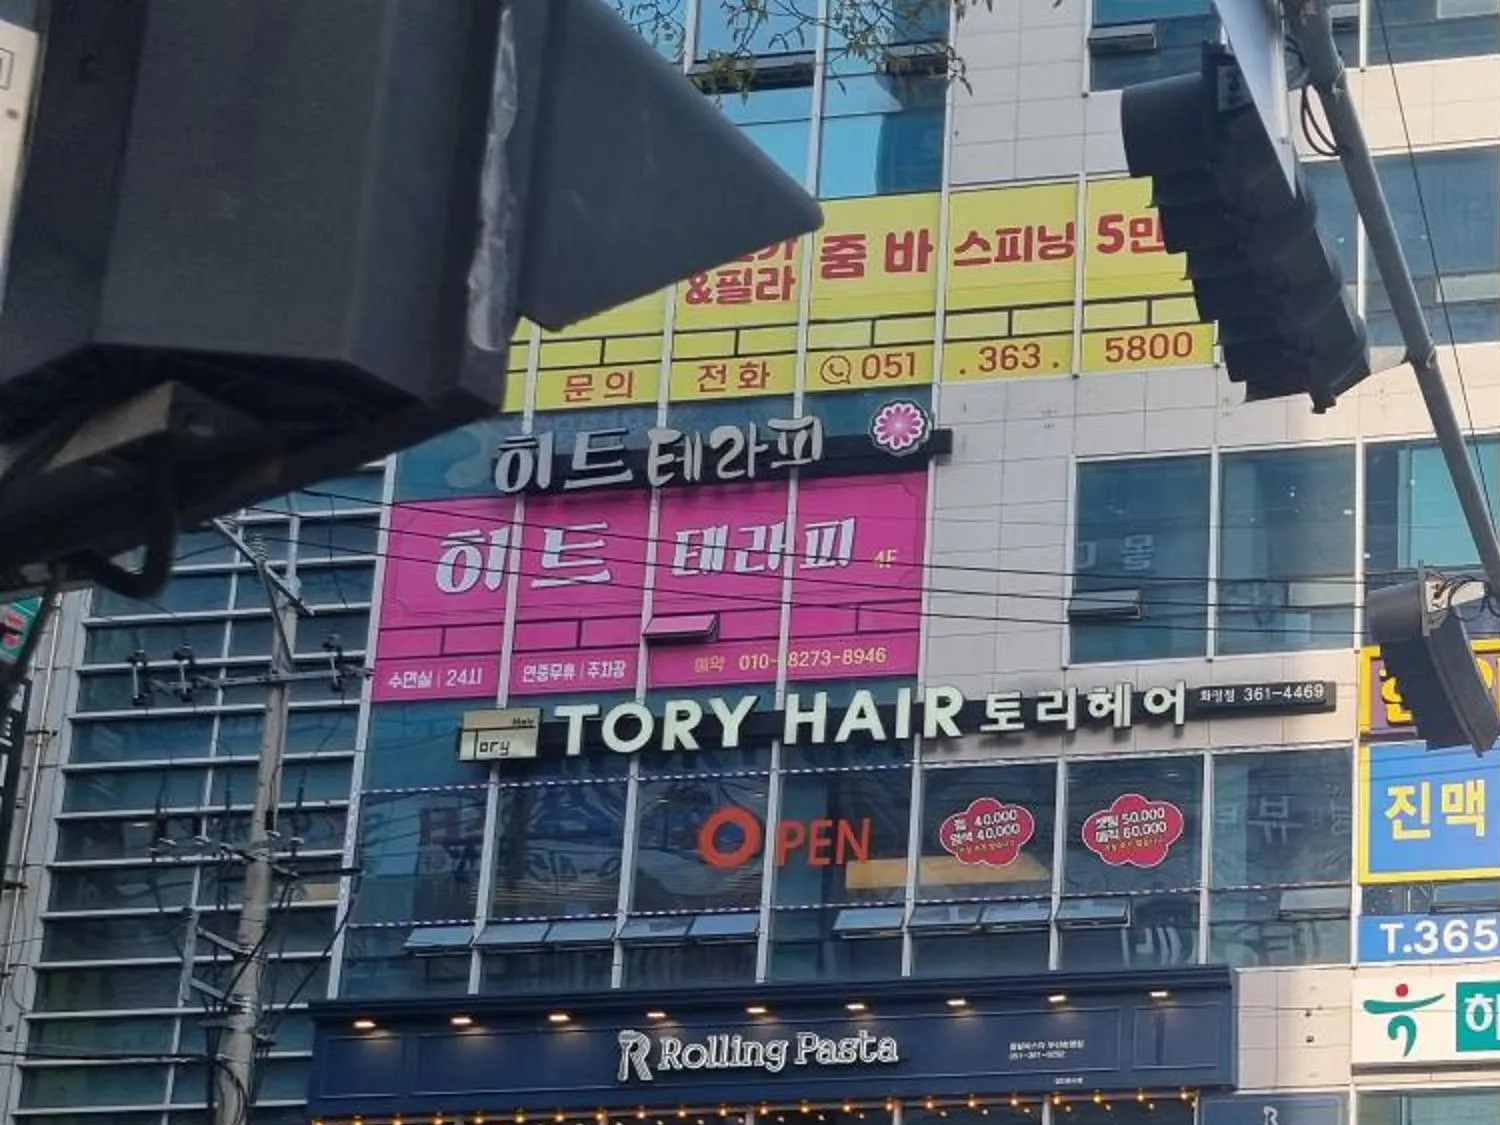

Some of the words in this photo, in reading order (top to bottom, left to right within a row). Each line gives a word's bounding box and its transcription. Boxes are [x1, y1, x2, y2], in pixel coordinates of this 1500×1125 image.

[953, 222, 1076, 268] 스피닝
[861, 352, 917, 381] 051
[1104, 331, 1194, 364] 5800
[671, 516, 857, 578] 테라피
[586, 659, 627, 679] 주차장
[553, 693, 764, 758] TORY
[783, 686, 964, 746] HAIR
[978, 680, 1187, 733] 토리헤어
[1242, 683, 1325, 702] 361-4469
[1384, 778, 1486, 841] 진맥
[696, 804, 872, 872] OPEN
[657, 1034, 789, 1073] Rolling
[794, 1029, 899, 1065] Pasta
